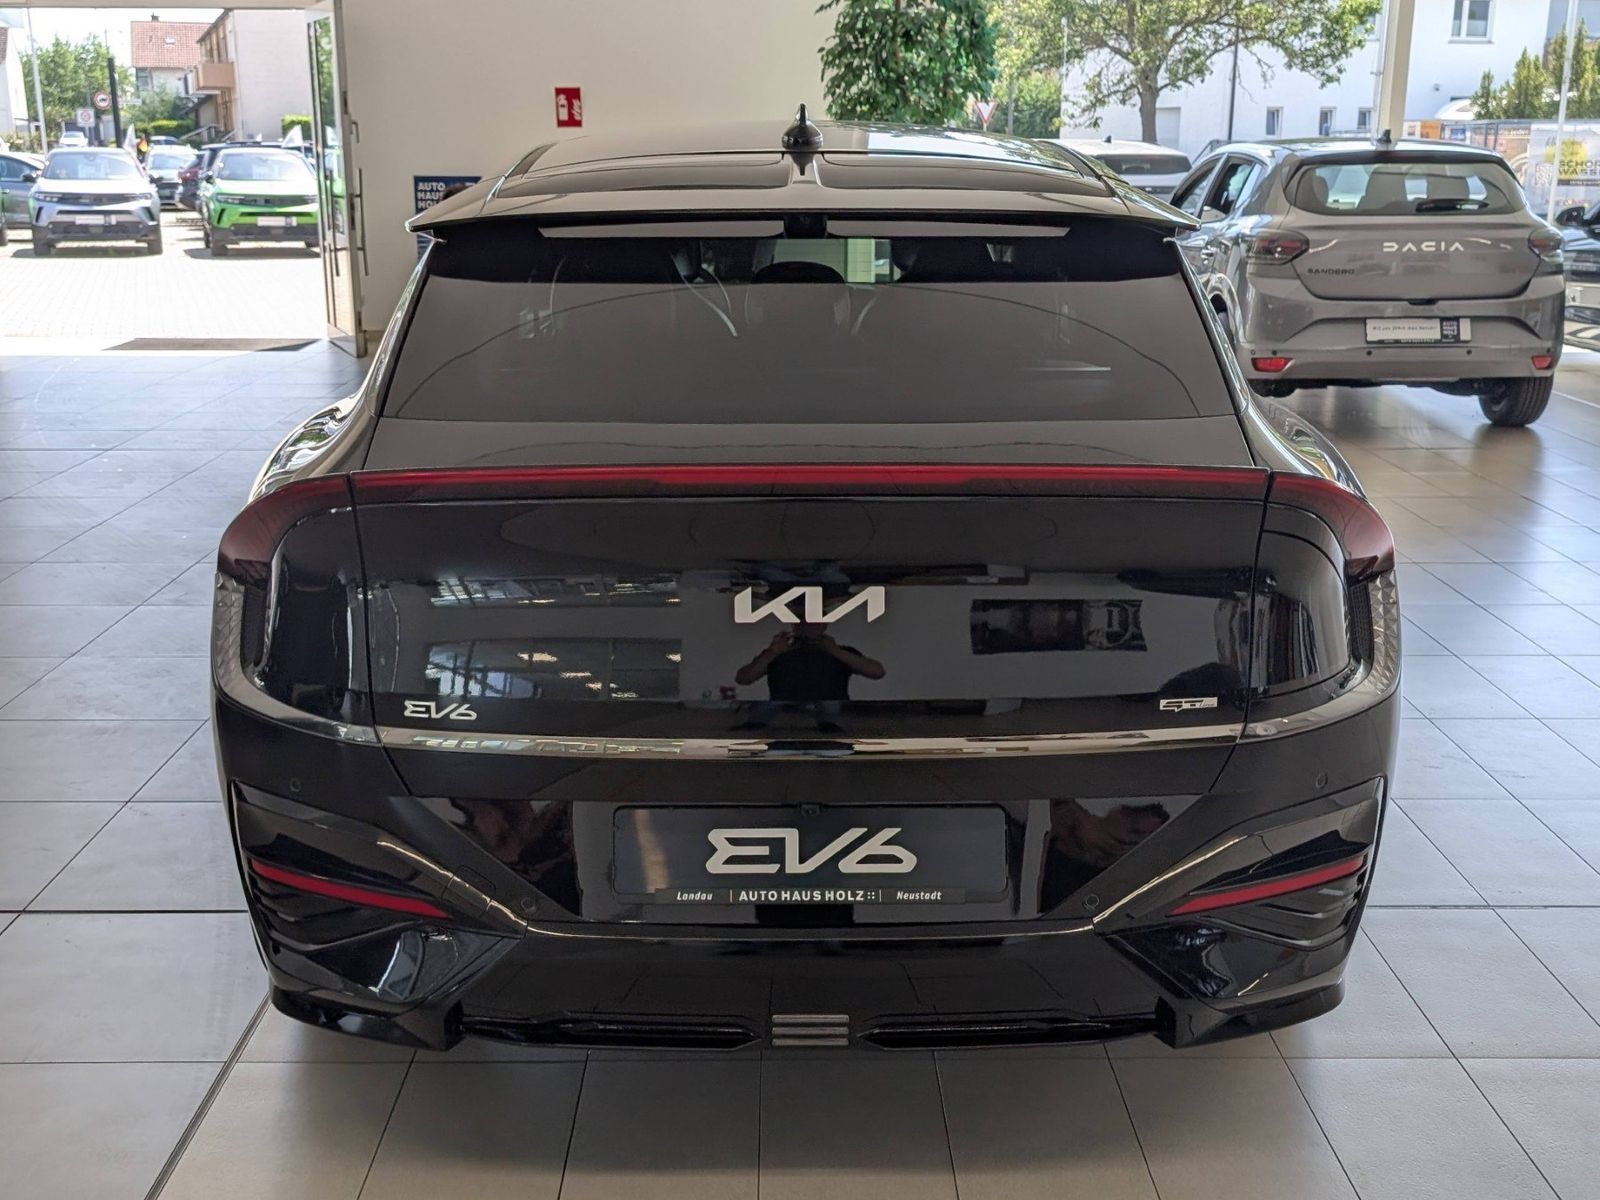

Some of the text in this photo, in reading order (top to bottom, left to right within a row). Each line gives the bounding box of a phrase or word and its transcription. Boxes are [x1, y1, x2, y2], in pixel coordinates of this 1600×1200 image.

[1558, 168, 1600, 176] WASS
[418, 182, 446, 191] AUTO
[1383, 241, 1464, 252] DACIA
[734, 586, 885, 623] KIA
[404, 700, 477, 720] EV6
[705, 827, 917, 874] EV6
[676, 890, 942, 901] Landau AUTO HAUS HOLZ Neustadt
